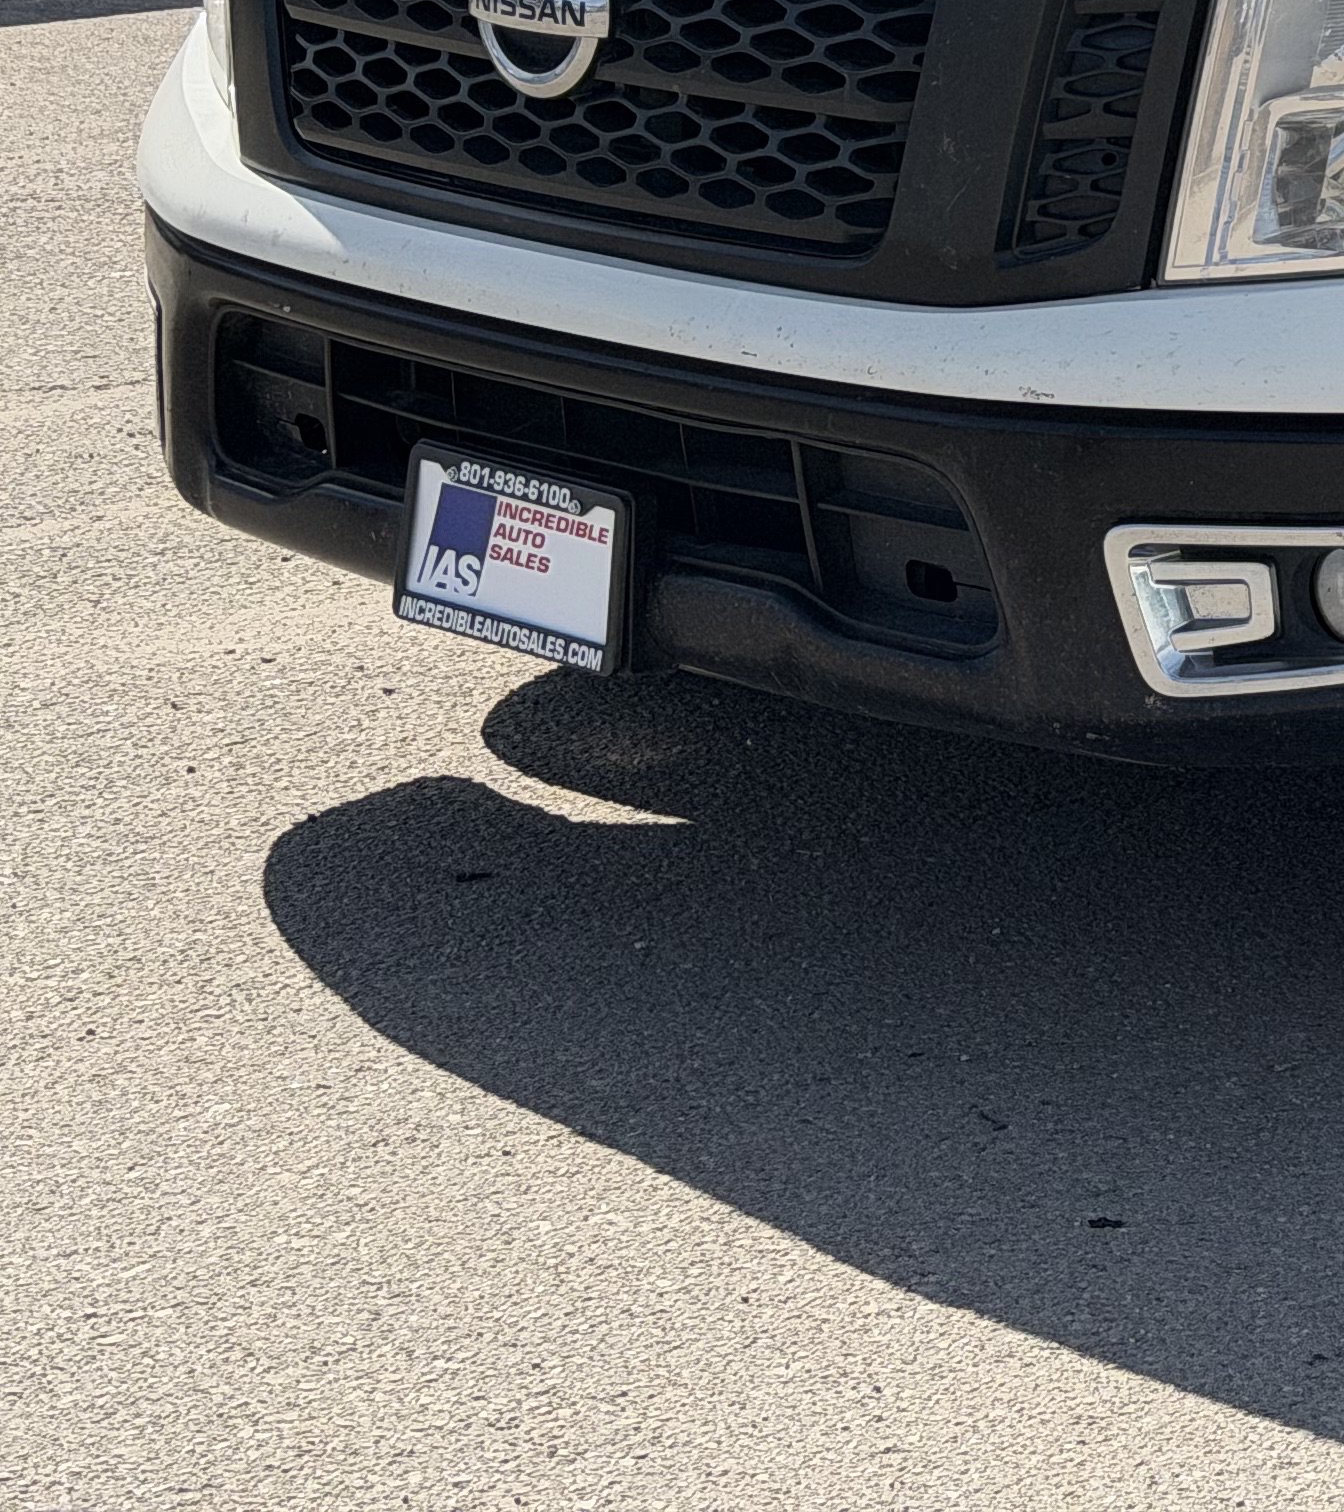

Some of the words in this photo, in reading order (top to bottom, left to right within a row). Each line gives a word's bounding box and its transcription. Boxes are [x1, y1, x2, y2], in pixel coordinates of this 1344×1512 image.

[459, 460, 571, 510] 801-936-6100
[493, 522, 546, 550] AUTO
[497, 500, 610, 546] INCREDIBLE
[418, 544, 482, 597] IAS
[488, 543, 551, 574] SALES
[398, 594, 604, 672] INCREDIBLEAUTOSALES.COM
